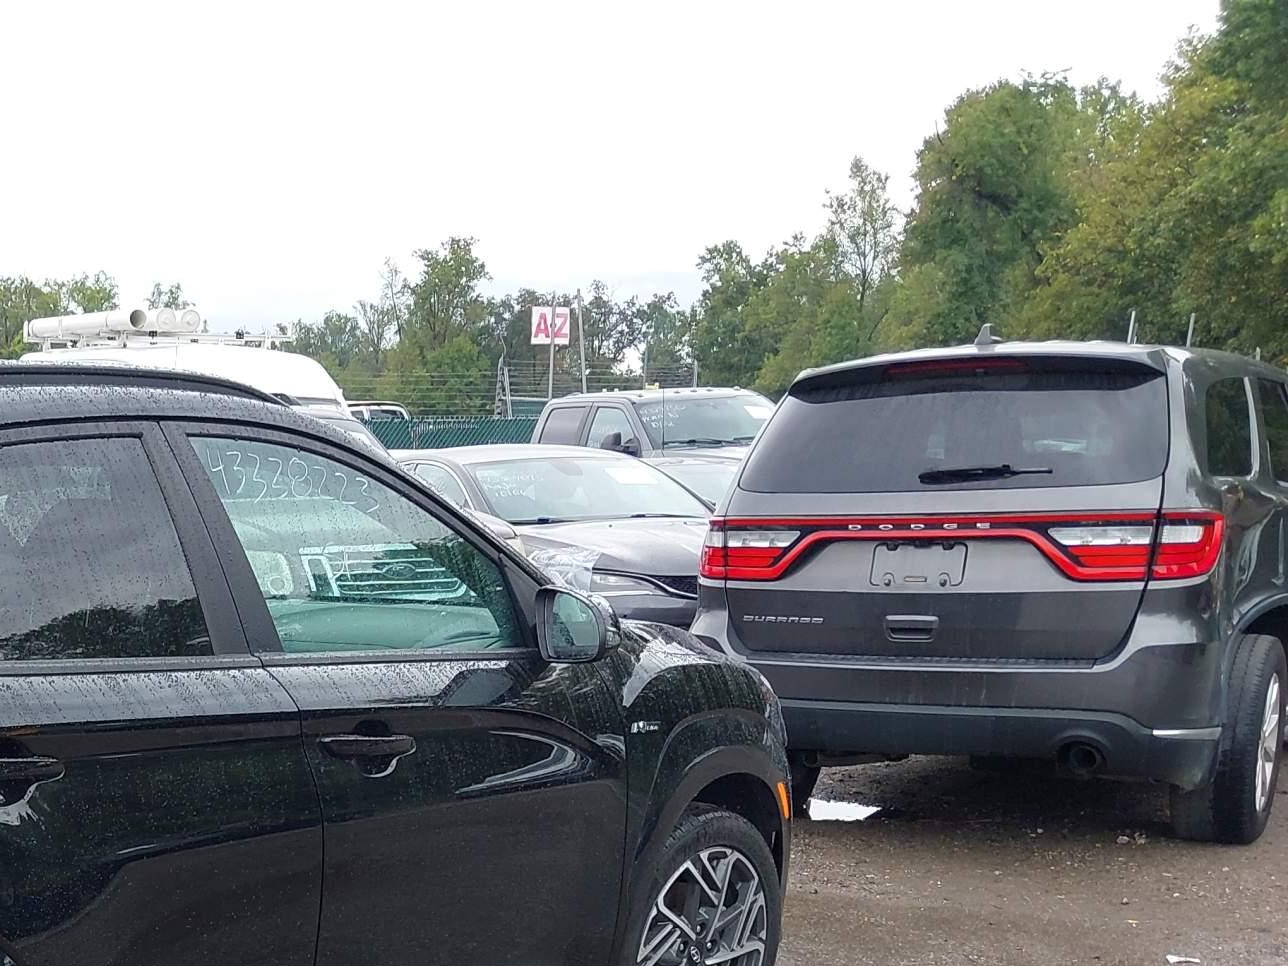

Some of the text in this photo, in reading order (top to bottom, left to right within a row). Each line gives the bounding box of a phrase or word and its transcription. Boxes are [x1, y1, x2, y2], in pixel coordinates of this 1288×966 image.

[207, 447, 380, 513] 43338223
[848, 522, 991, 531] DODGE
[743, 615, 824, 624] DURANGO
